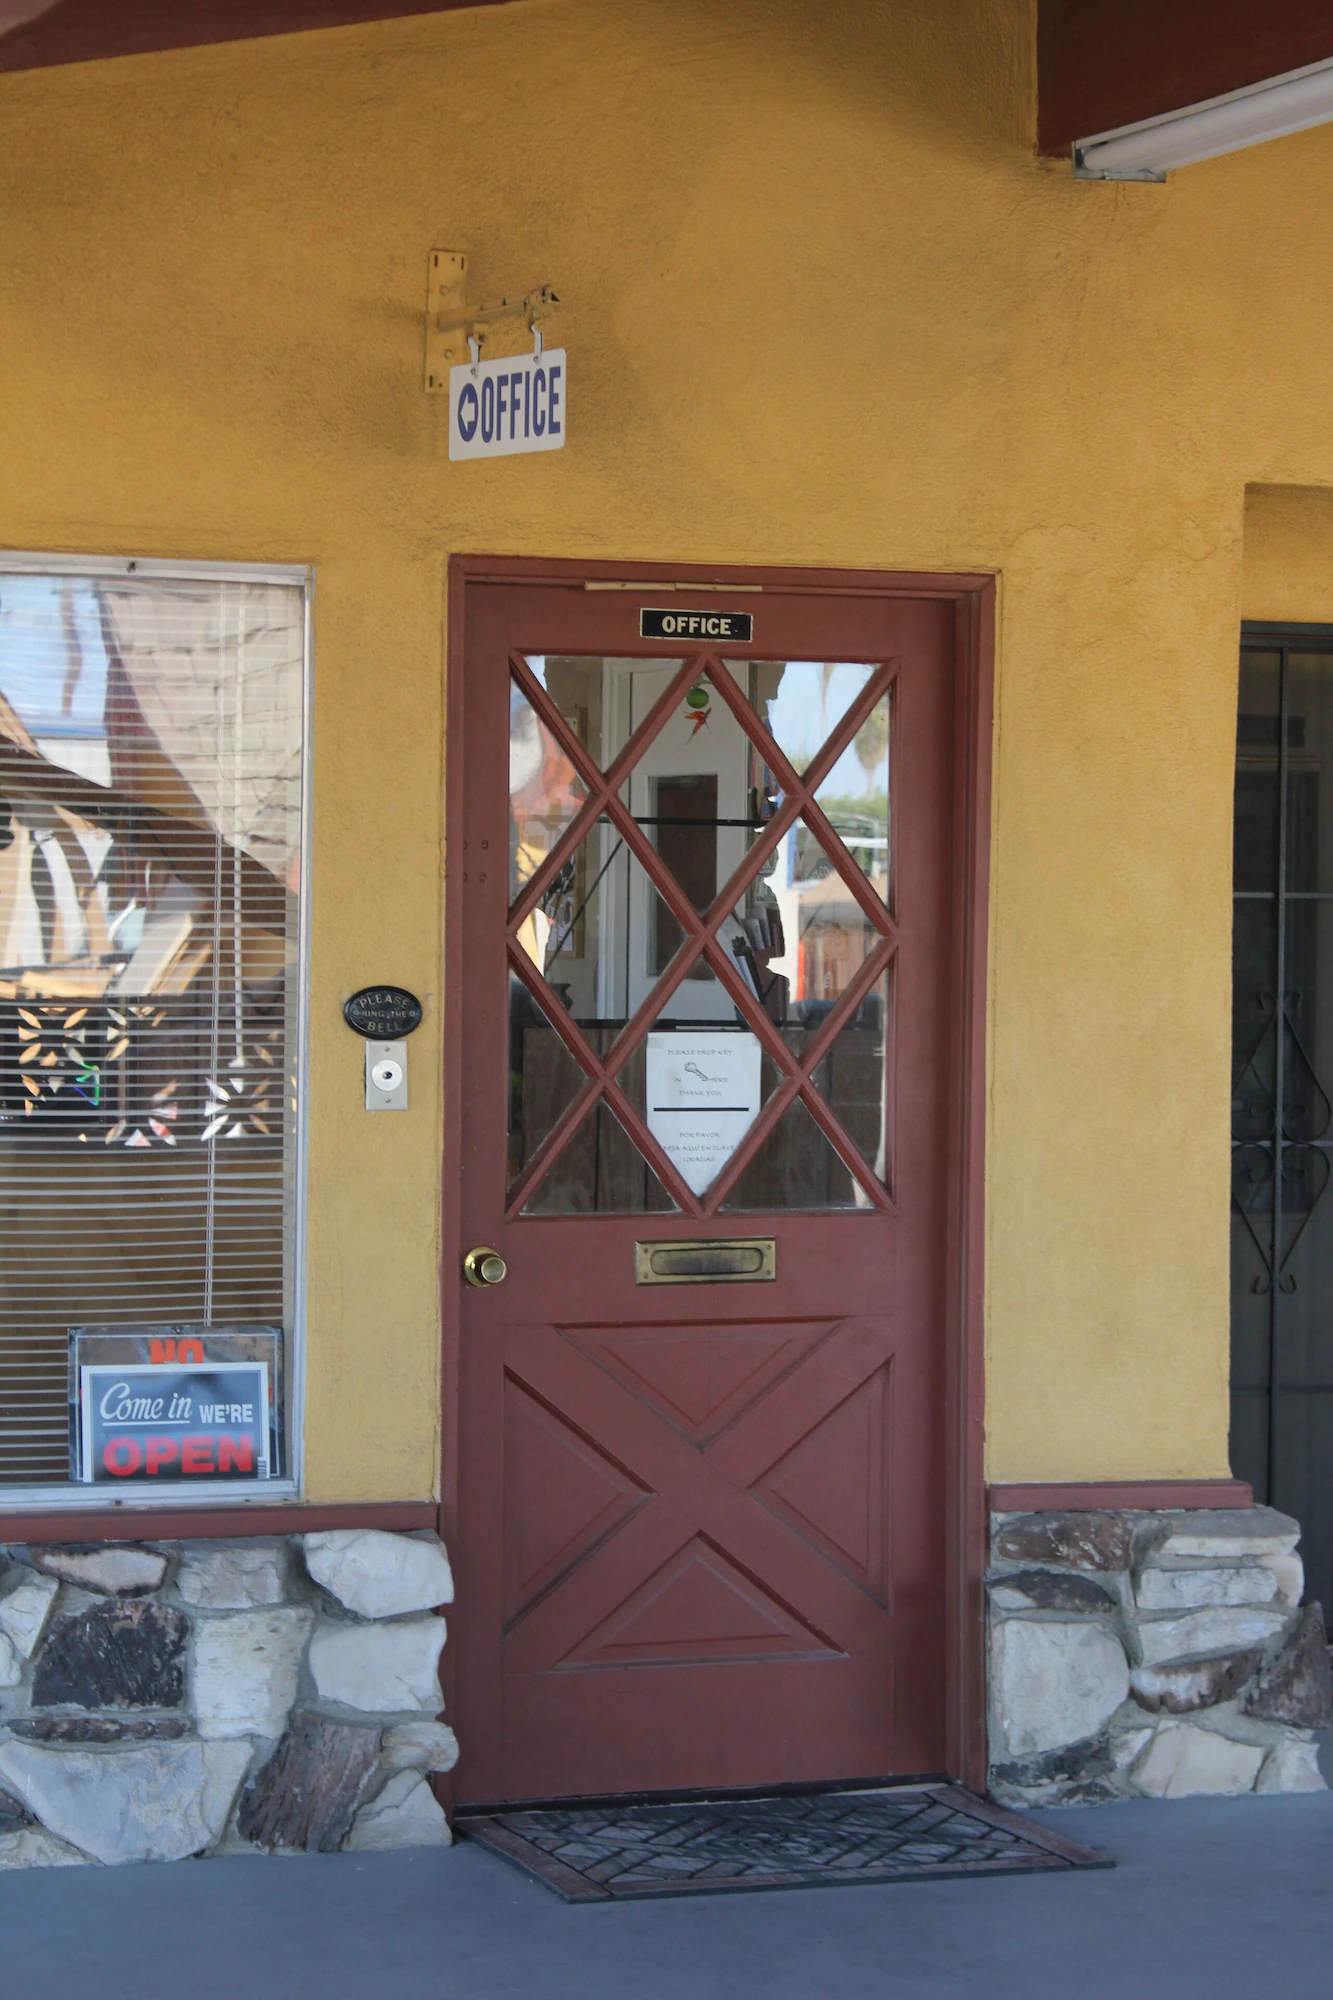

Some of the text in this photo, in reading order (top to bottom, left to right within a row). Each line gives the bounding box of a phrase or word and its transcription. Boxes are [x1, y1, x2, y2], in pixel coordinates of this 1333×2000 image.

[481, 366, 561, 444] OFFICE
[661, 615, 732, 635] OFFICE
[359, 994, 410, 1009] PLEASE
[391, 1010, 407, 1018] THE
[367, 1021, 402, 1033] BELL
[717, 1049, 733, 1057] KEY
[150, 1338, 205, 1365] NO
[100, 1382, 254, 1424] Come in WE'RE
[102, 1434, 253, 1477] OPEN
